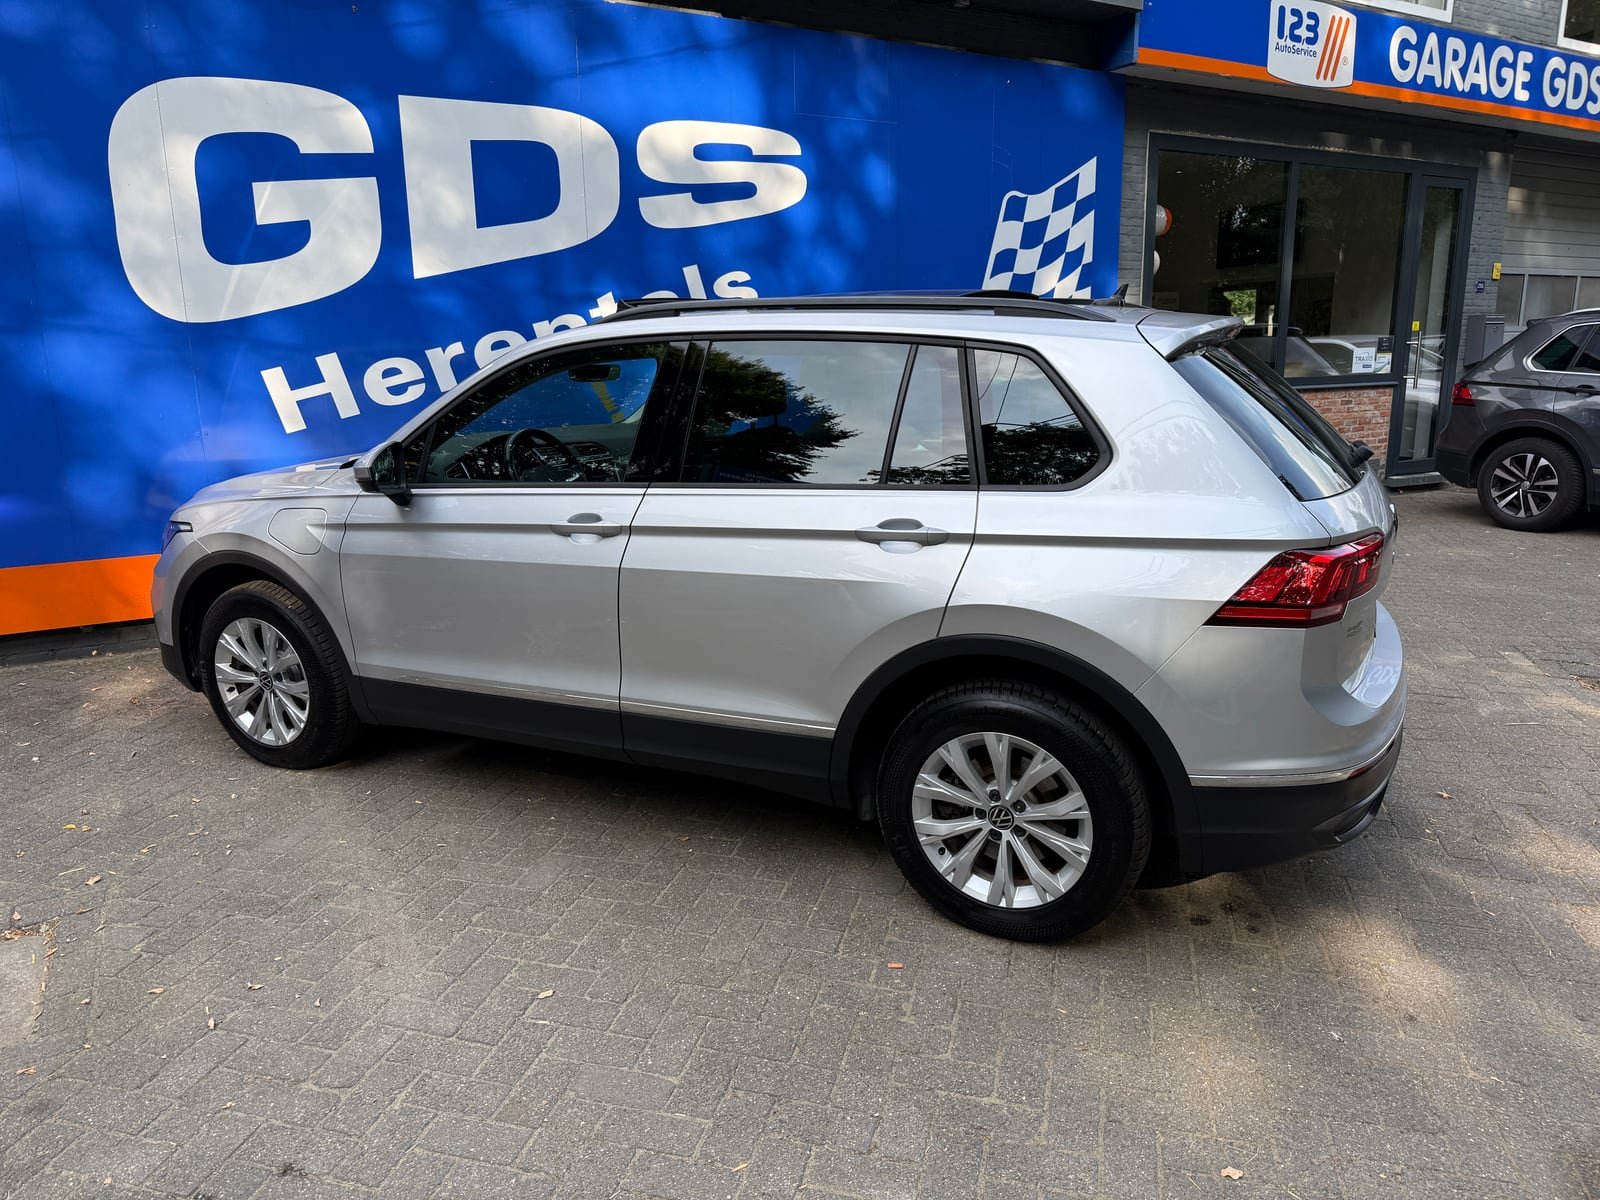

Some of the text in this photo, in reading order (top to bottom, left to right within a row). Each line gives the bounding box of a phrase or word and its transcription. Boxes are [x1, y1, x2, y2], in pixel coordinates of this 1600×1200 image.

[1275, 42, 1317, 58] AutoService
[1389, 26, 1600, 115] GARAGE GDS
[108, 76, 807, 323] GDS
